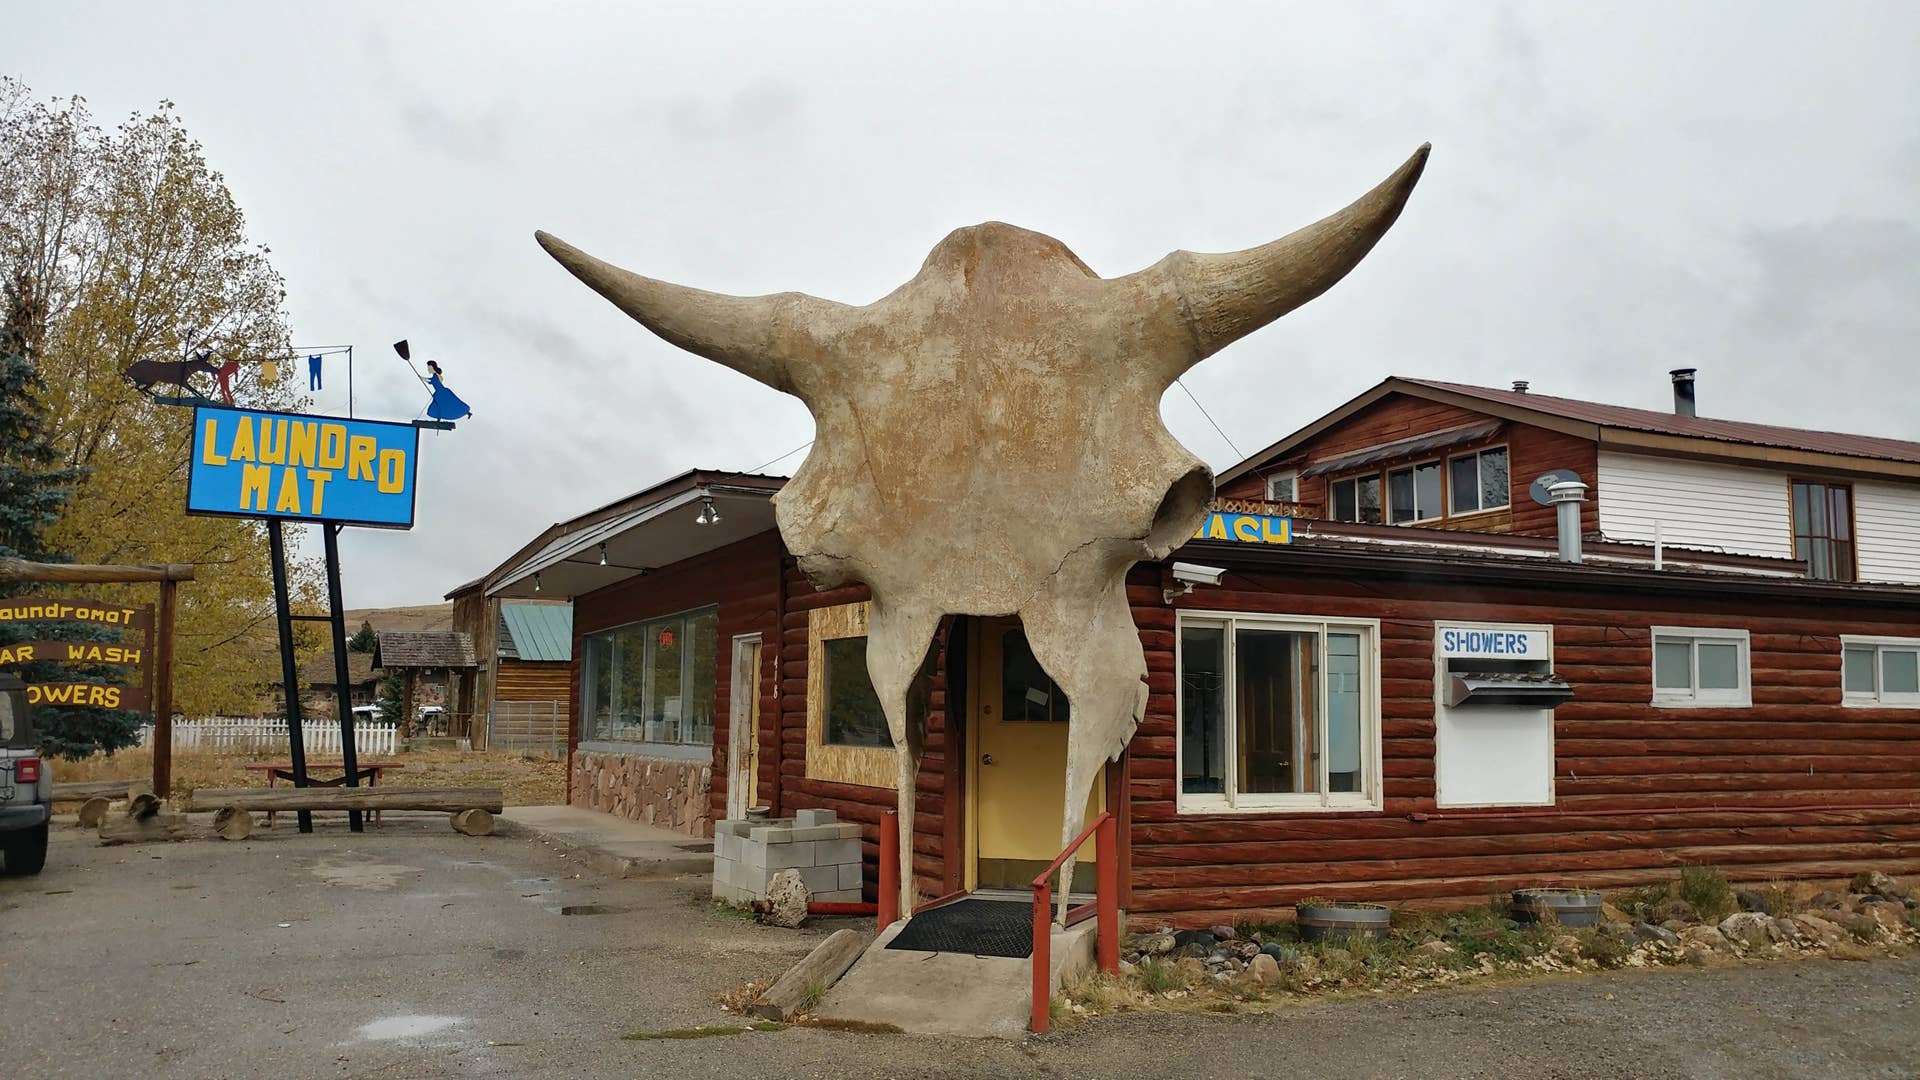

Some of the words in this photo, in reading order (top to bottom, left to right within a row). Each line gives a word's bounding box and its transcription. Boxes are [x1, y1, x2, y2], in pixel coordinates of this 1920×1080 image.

[203, 416, 406, 494] LAUNDRO
[239, 464, 332, 515] MAT
[1194, 514, 1289, 544] ASH
[67, 644, 141, 664] WASH
[1443, 631, 1528, 655] SHOWERS
